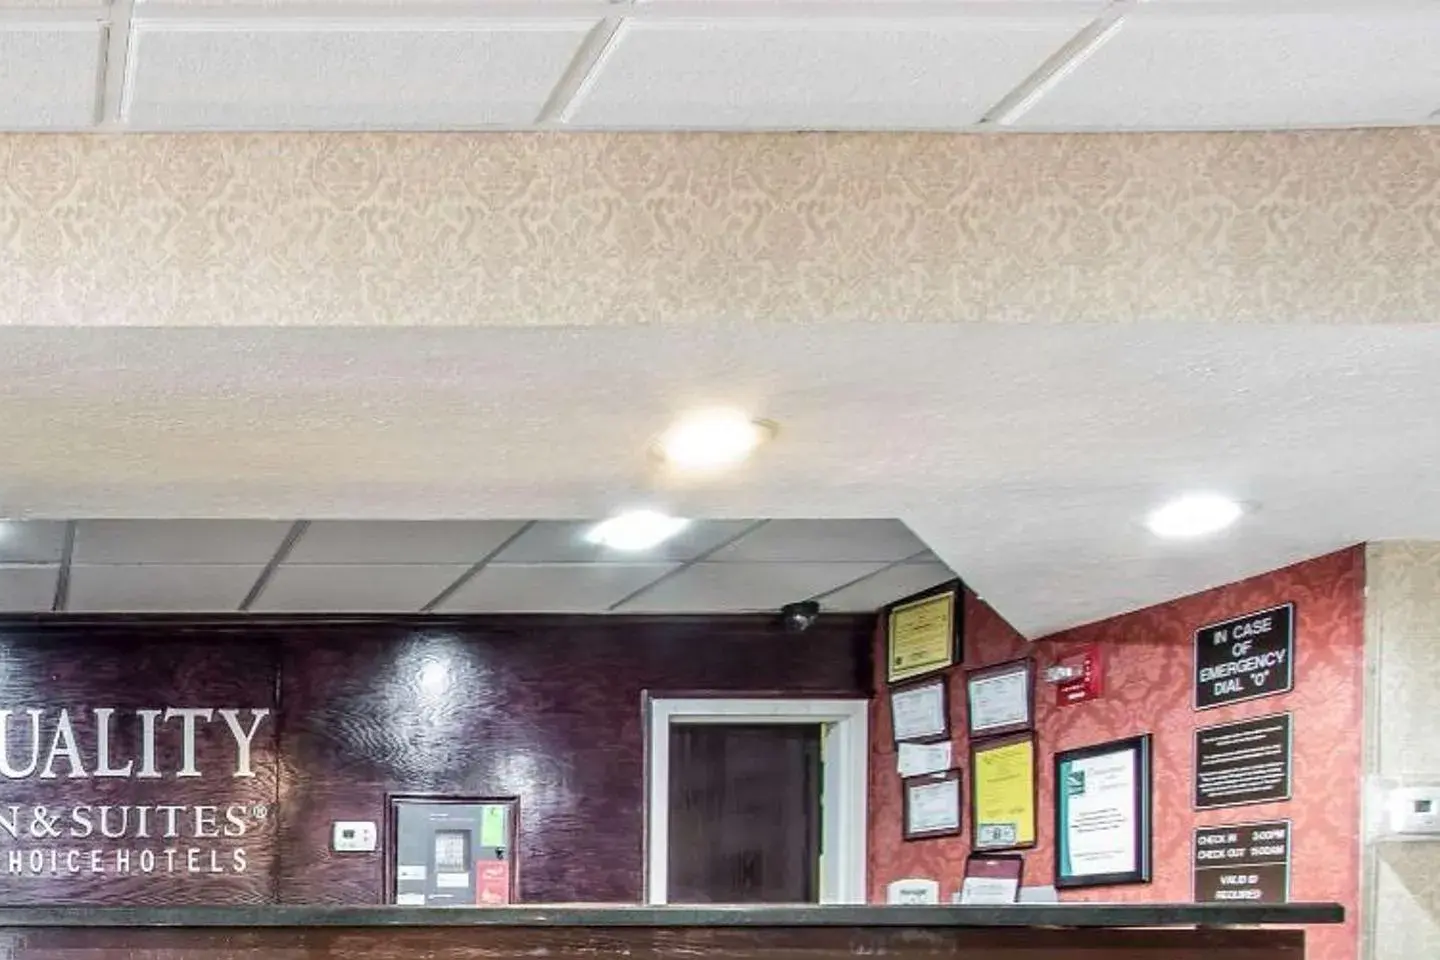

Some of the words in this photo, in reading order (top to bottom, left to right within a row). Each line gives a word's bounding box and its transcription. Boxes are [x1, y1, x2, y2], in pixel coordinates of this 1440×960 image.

[1213, 629, 1228, 646] IN
[1232, 617, 1272, 639] CASE
[1231, 640, 1253, 658] OF
[1200, 648, 1287, 683] EMERGENCY
[1213, 677, 1245, 697] DIAL
